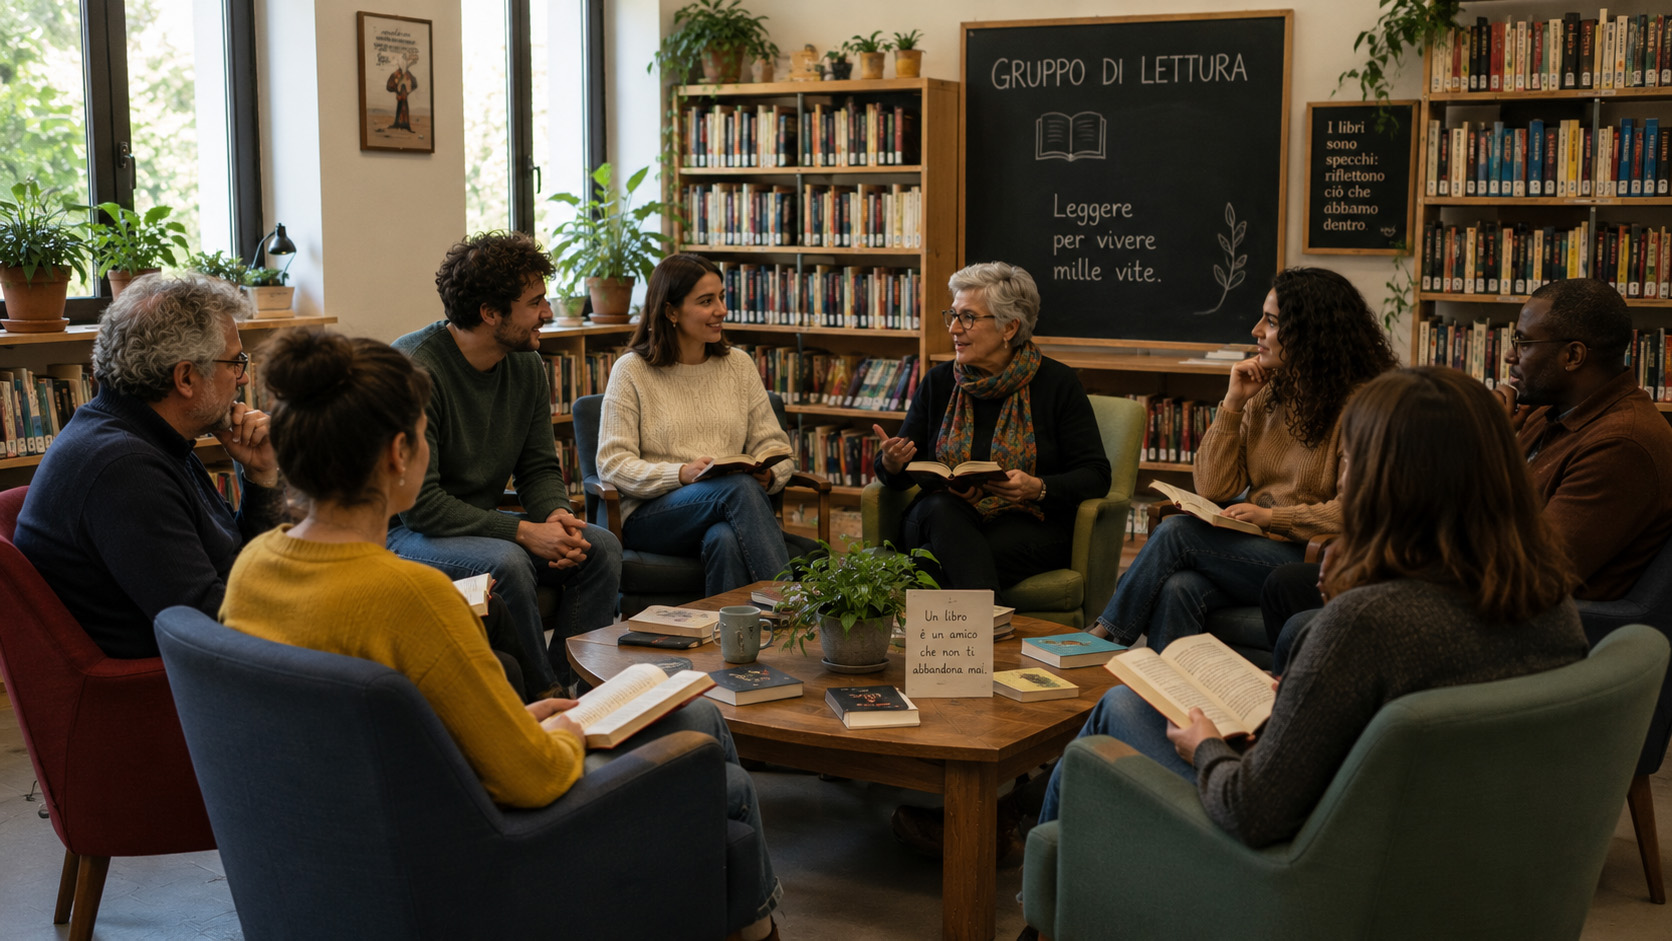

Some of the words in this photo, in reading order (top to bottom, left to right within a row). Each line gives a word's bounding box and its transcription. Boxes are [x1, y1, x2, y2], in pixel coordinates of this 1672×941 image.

[991, 57, 1086, 90] GRUPPO
[1102, 57, 1123, 85] DI
[1141, 53, 1248, 84] LETTURA
[1327, 121, 1333, 134] I
[1338, 121, 1365, 134] libri
[1326, 140, 1358, 150] sono
[1325, 153, 1379, 168] specchi:
[1325, 169, 1385, 182] riflettono
[1347, 185, 1371, 198] che
[1053, 193, 1133, 226] Leggere
[1053, 234, 1085, 256] per
[1097, 230, 1157, 250] vivere
[1053, 257, 1102, 281] mille
[1115, 260, 1162, 282] vite.
[924, 609, 939, 622] Un
[944, 609, 968, 622] libro
[931, 632, 944, 640] un
[949, 628, 978, 639] amico
[919, 645, 937, 657] che
[942, 649, 960, 657] non
[966, 645, 975, 657] ti
[912, 663, 963, 675] abbandona
[968, 662, 988, 675] mai.
